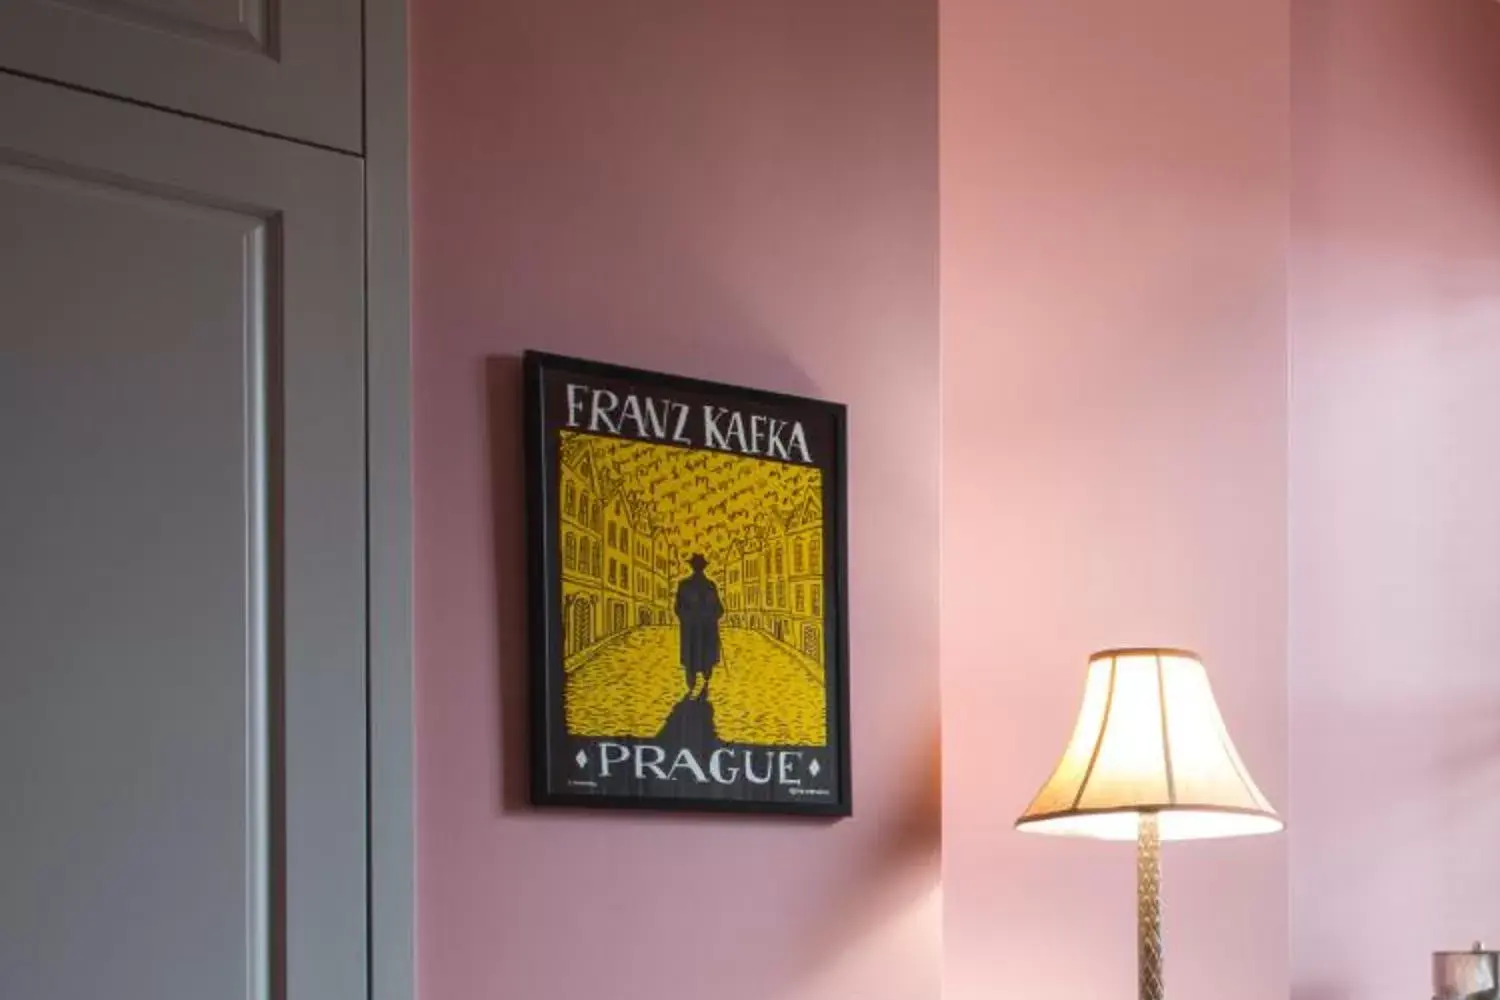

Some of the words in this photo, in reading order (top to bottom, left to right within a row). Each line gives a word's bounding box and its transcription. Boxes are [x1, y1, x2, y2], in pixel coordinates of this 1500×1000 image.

[566, 383, 692, 446] FRANZ
[703, 404, 813, 463] KAFKA
[598, 741, 803, 785] PRAGUE
